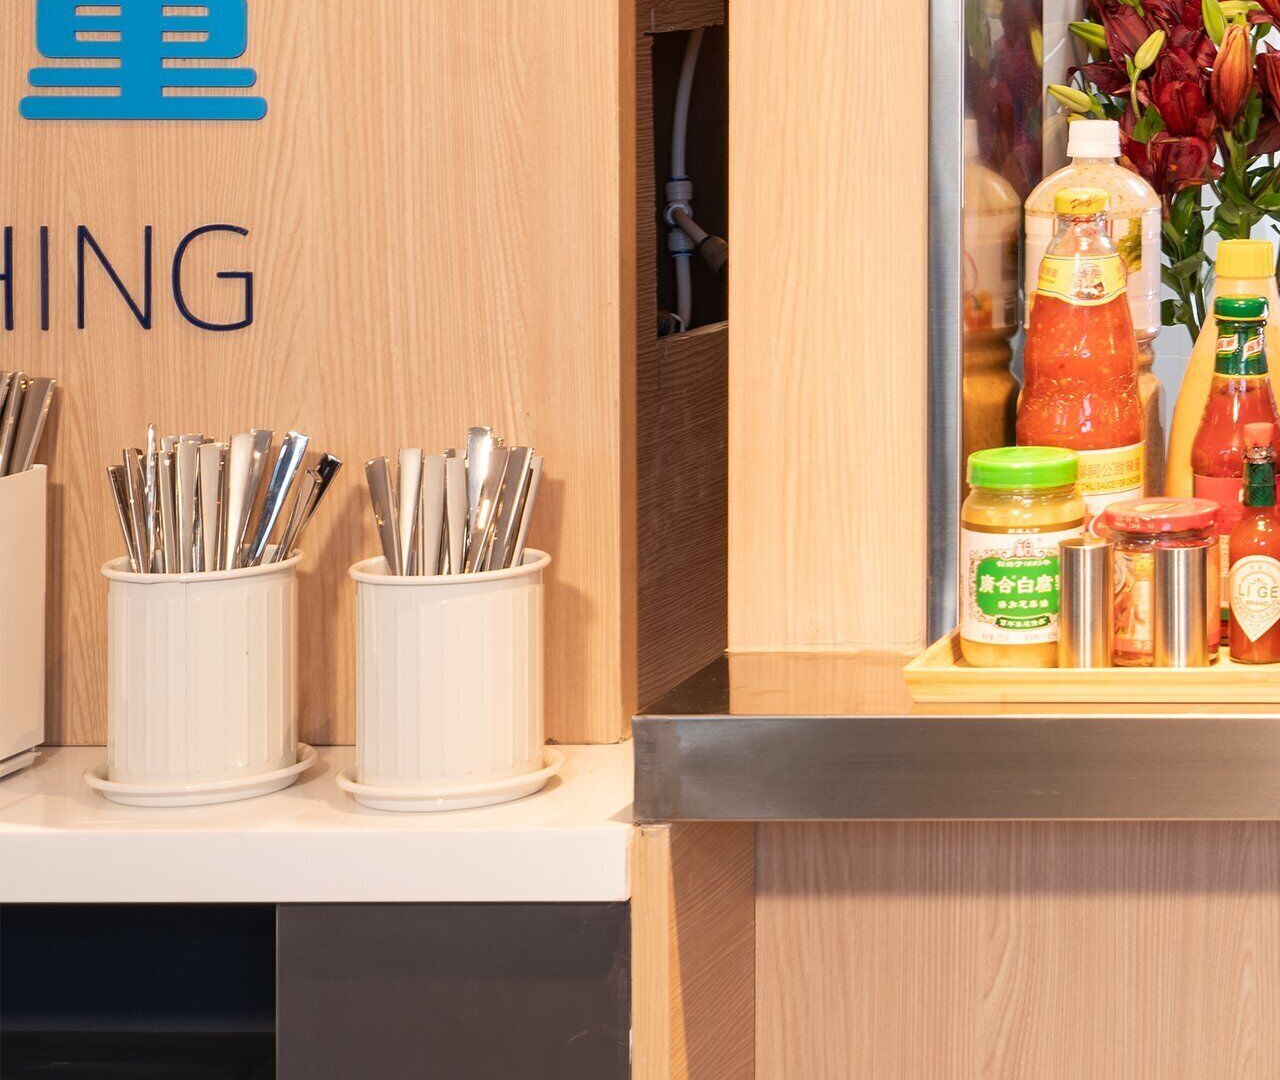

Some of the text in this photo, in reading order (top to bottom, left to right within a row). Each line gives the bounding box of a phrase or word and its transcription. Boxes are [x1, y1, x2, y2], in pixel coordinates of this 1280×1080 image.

[0, 223, 254, 332] ING
[979, 574, 1059, 594] 廣合白腐
